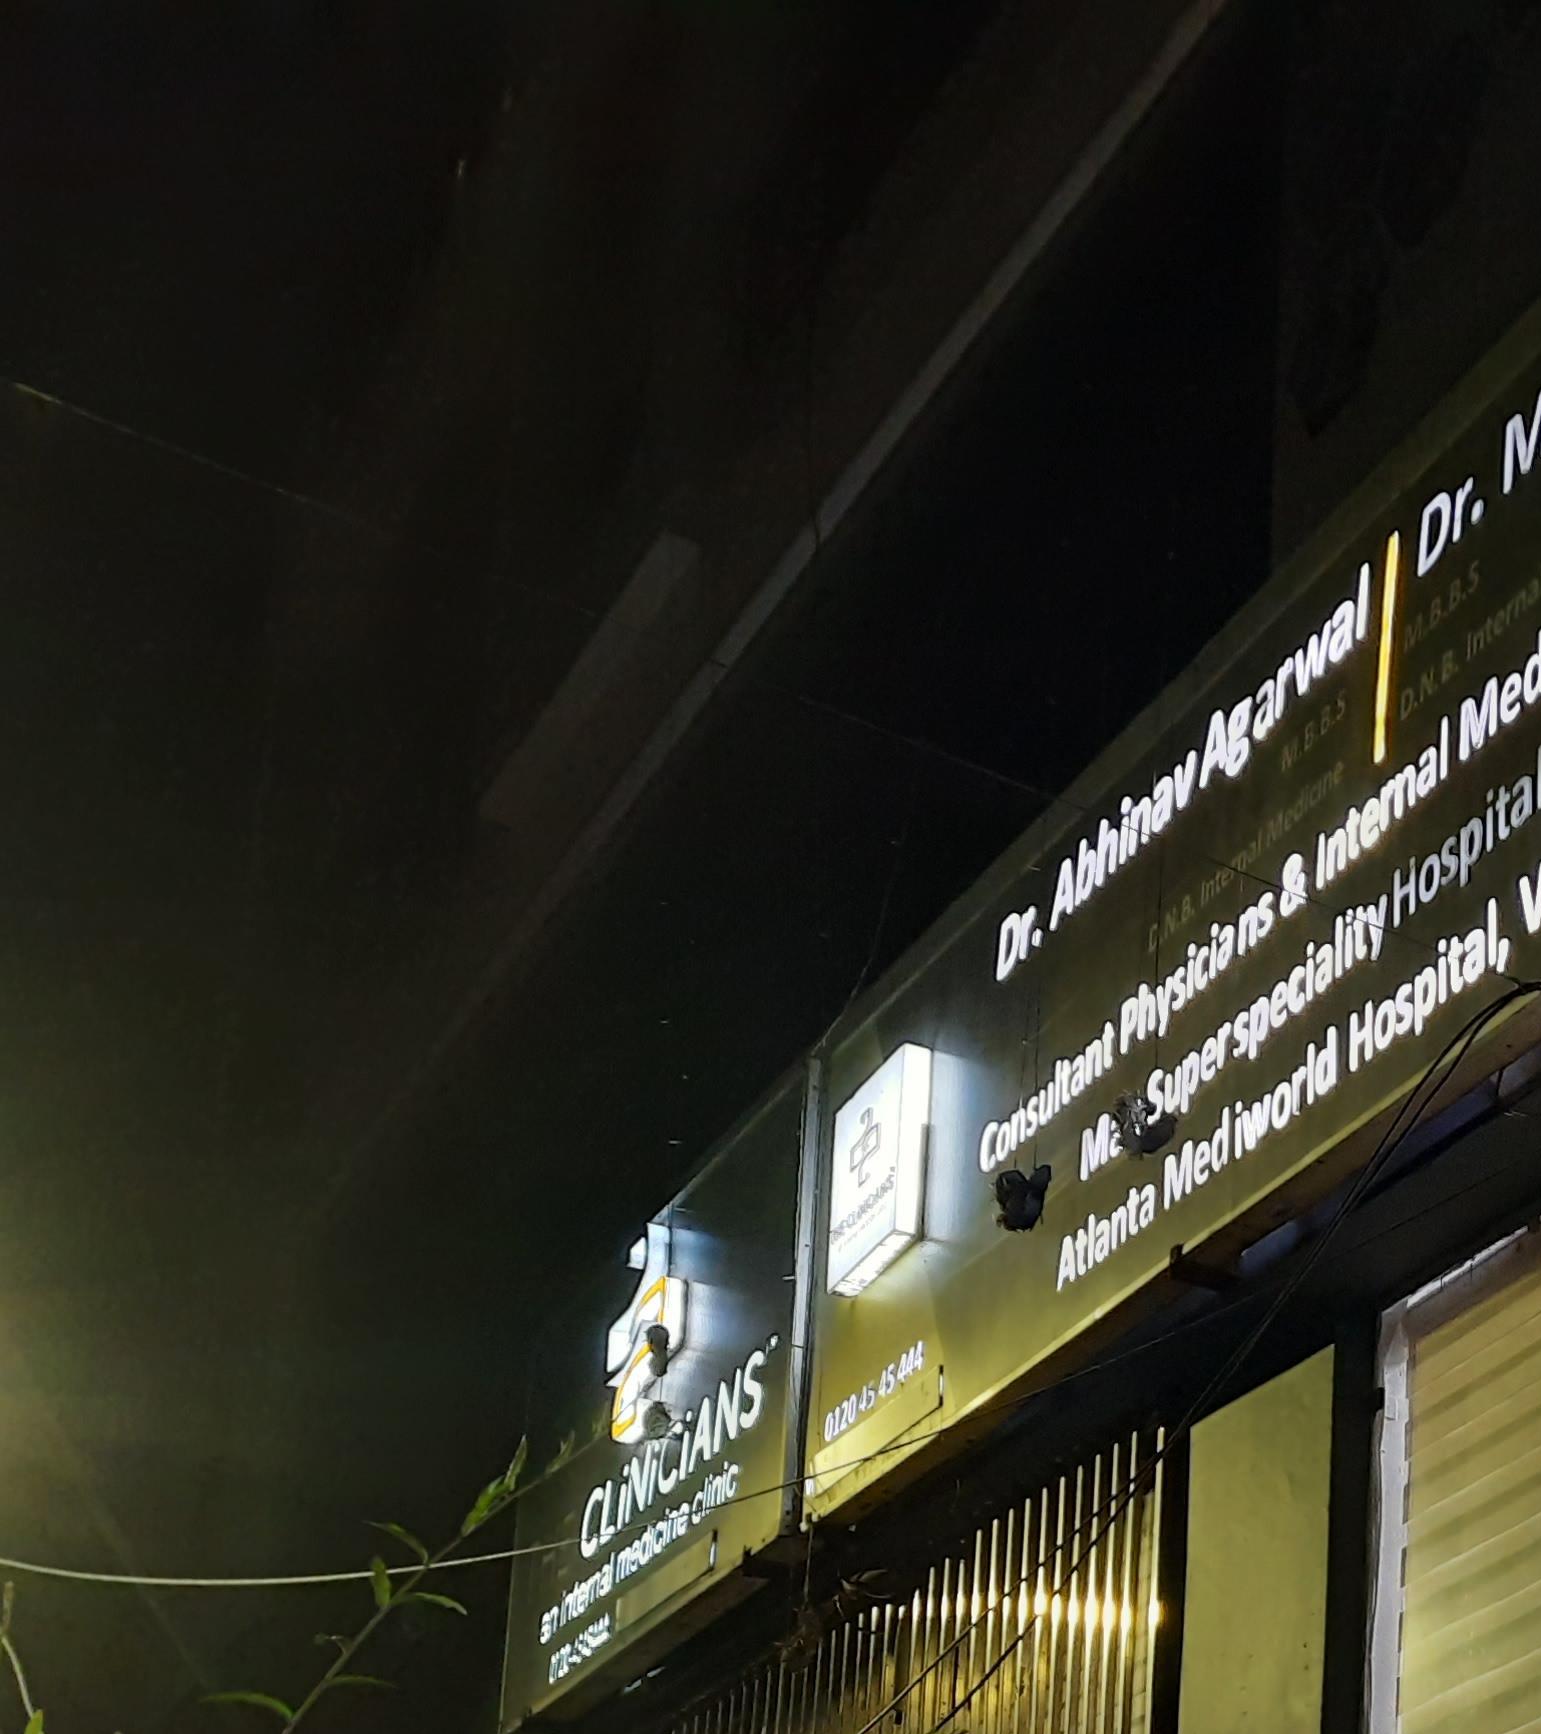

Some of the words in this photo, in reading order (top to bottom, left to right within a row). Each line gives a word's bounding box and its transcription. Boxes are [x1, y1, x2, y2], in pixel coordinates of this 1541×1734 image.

[996, 905, 1044, 981] Dr.
[1049, 749, 1199, 932] Abhinav
[1199, 561, 1371, 789] Agarwal
[1417, 476, 1485, 578] Dr.
[979, 1020, 1115, 1173] Consultant
[1119, 903, 1274, 1056] Physicians
[1278, 852, 1308, 918] &
[1316, 714, 1449, 890] Internal
[1055, 1180, 1156, 1293] Atlanta
[1162, 1025, 1338, 1210] Mediworld
[1349, 897, 1510, 1073] Hospital,
[824, 1396, 857, 1443] 0120
